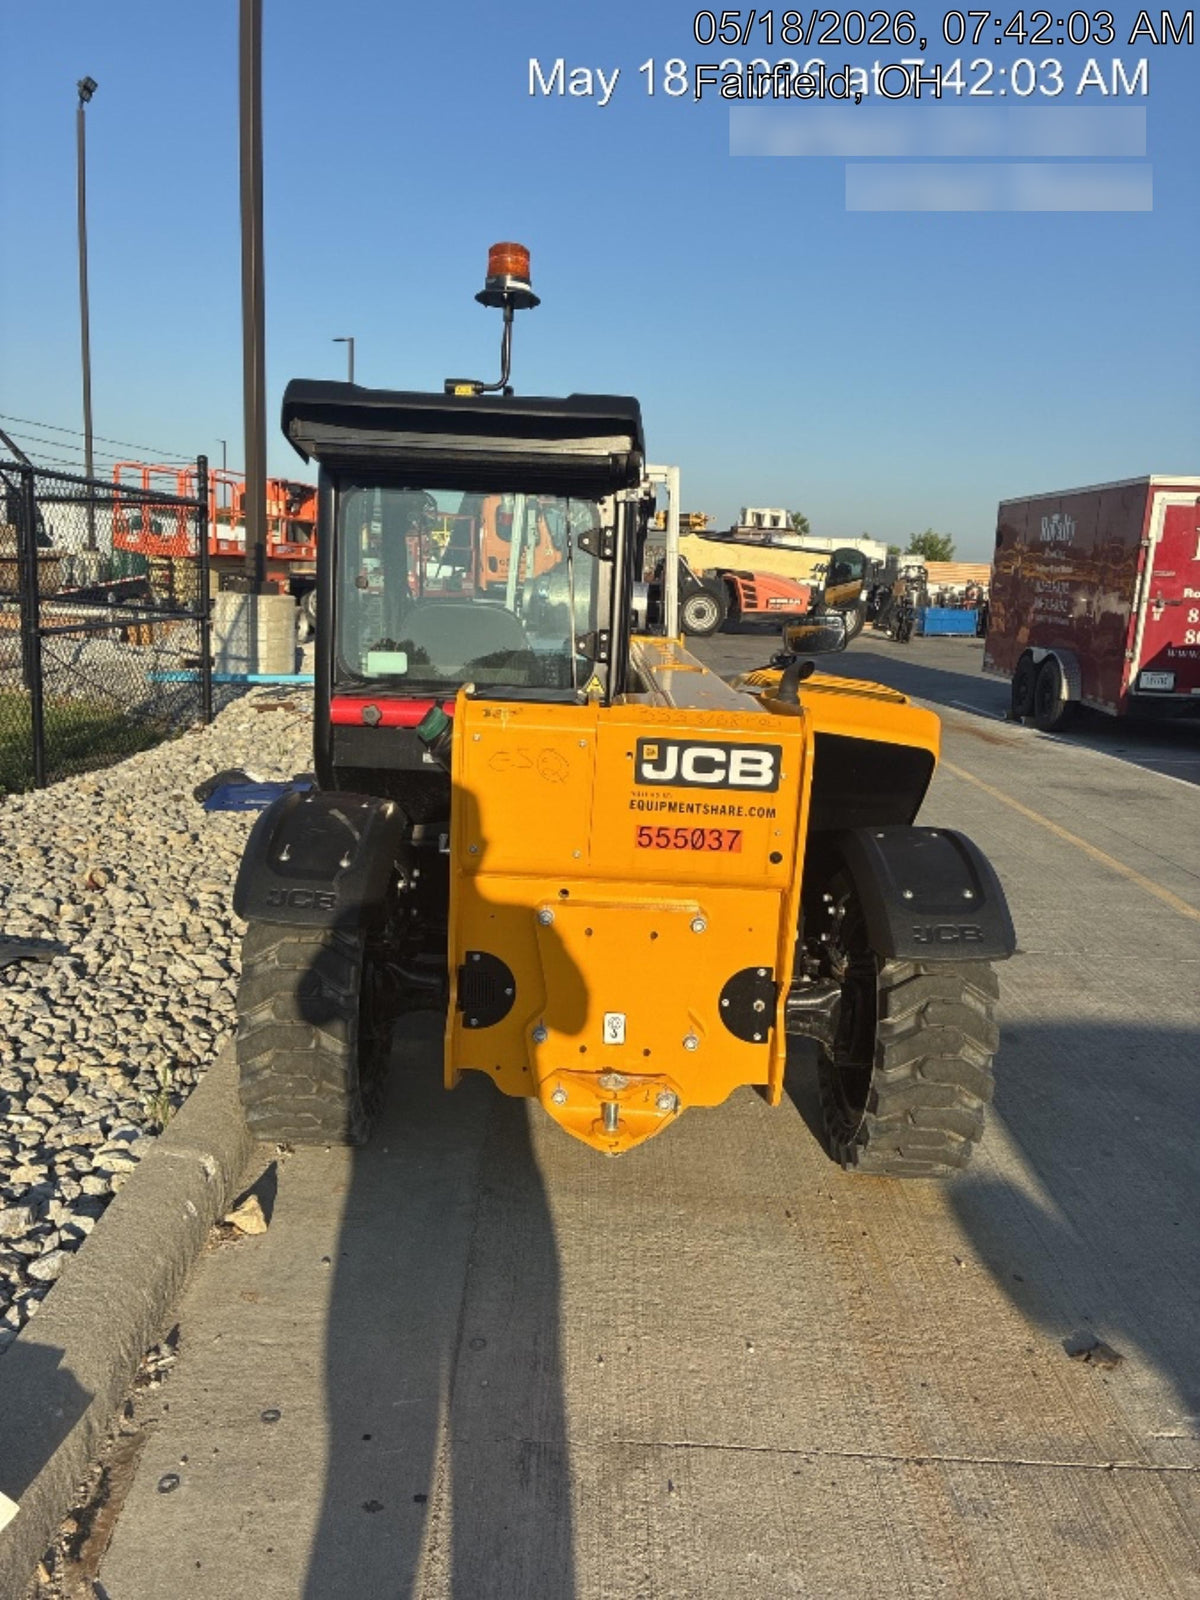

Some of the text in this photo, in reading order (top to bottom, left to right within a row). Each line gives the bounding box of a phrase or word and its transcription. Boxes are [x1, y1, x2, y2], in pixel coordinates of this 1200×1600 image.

[641, 745, 775, 786] JCB
[629, 799, 777, 818] EQUIPMENTSHARE.COM
[637, 825, 742, 851] 555037
[266, 888, 337, 911] JCB
[912, 923, 984, 945] JCB
